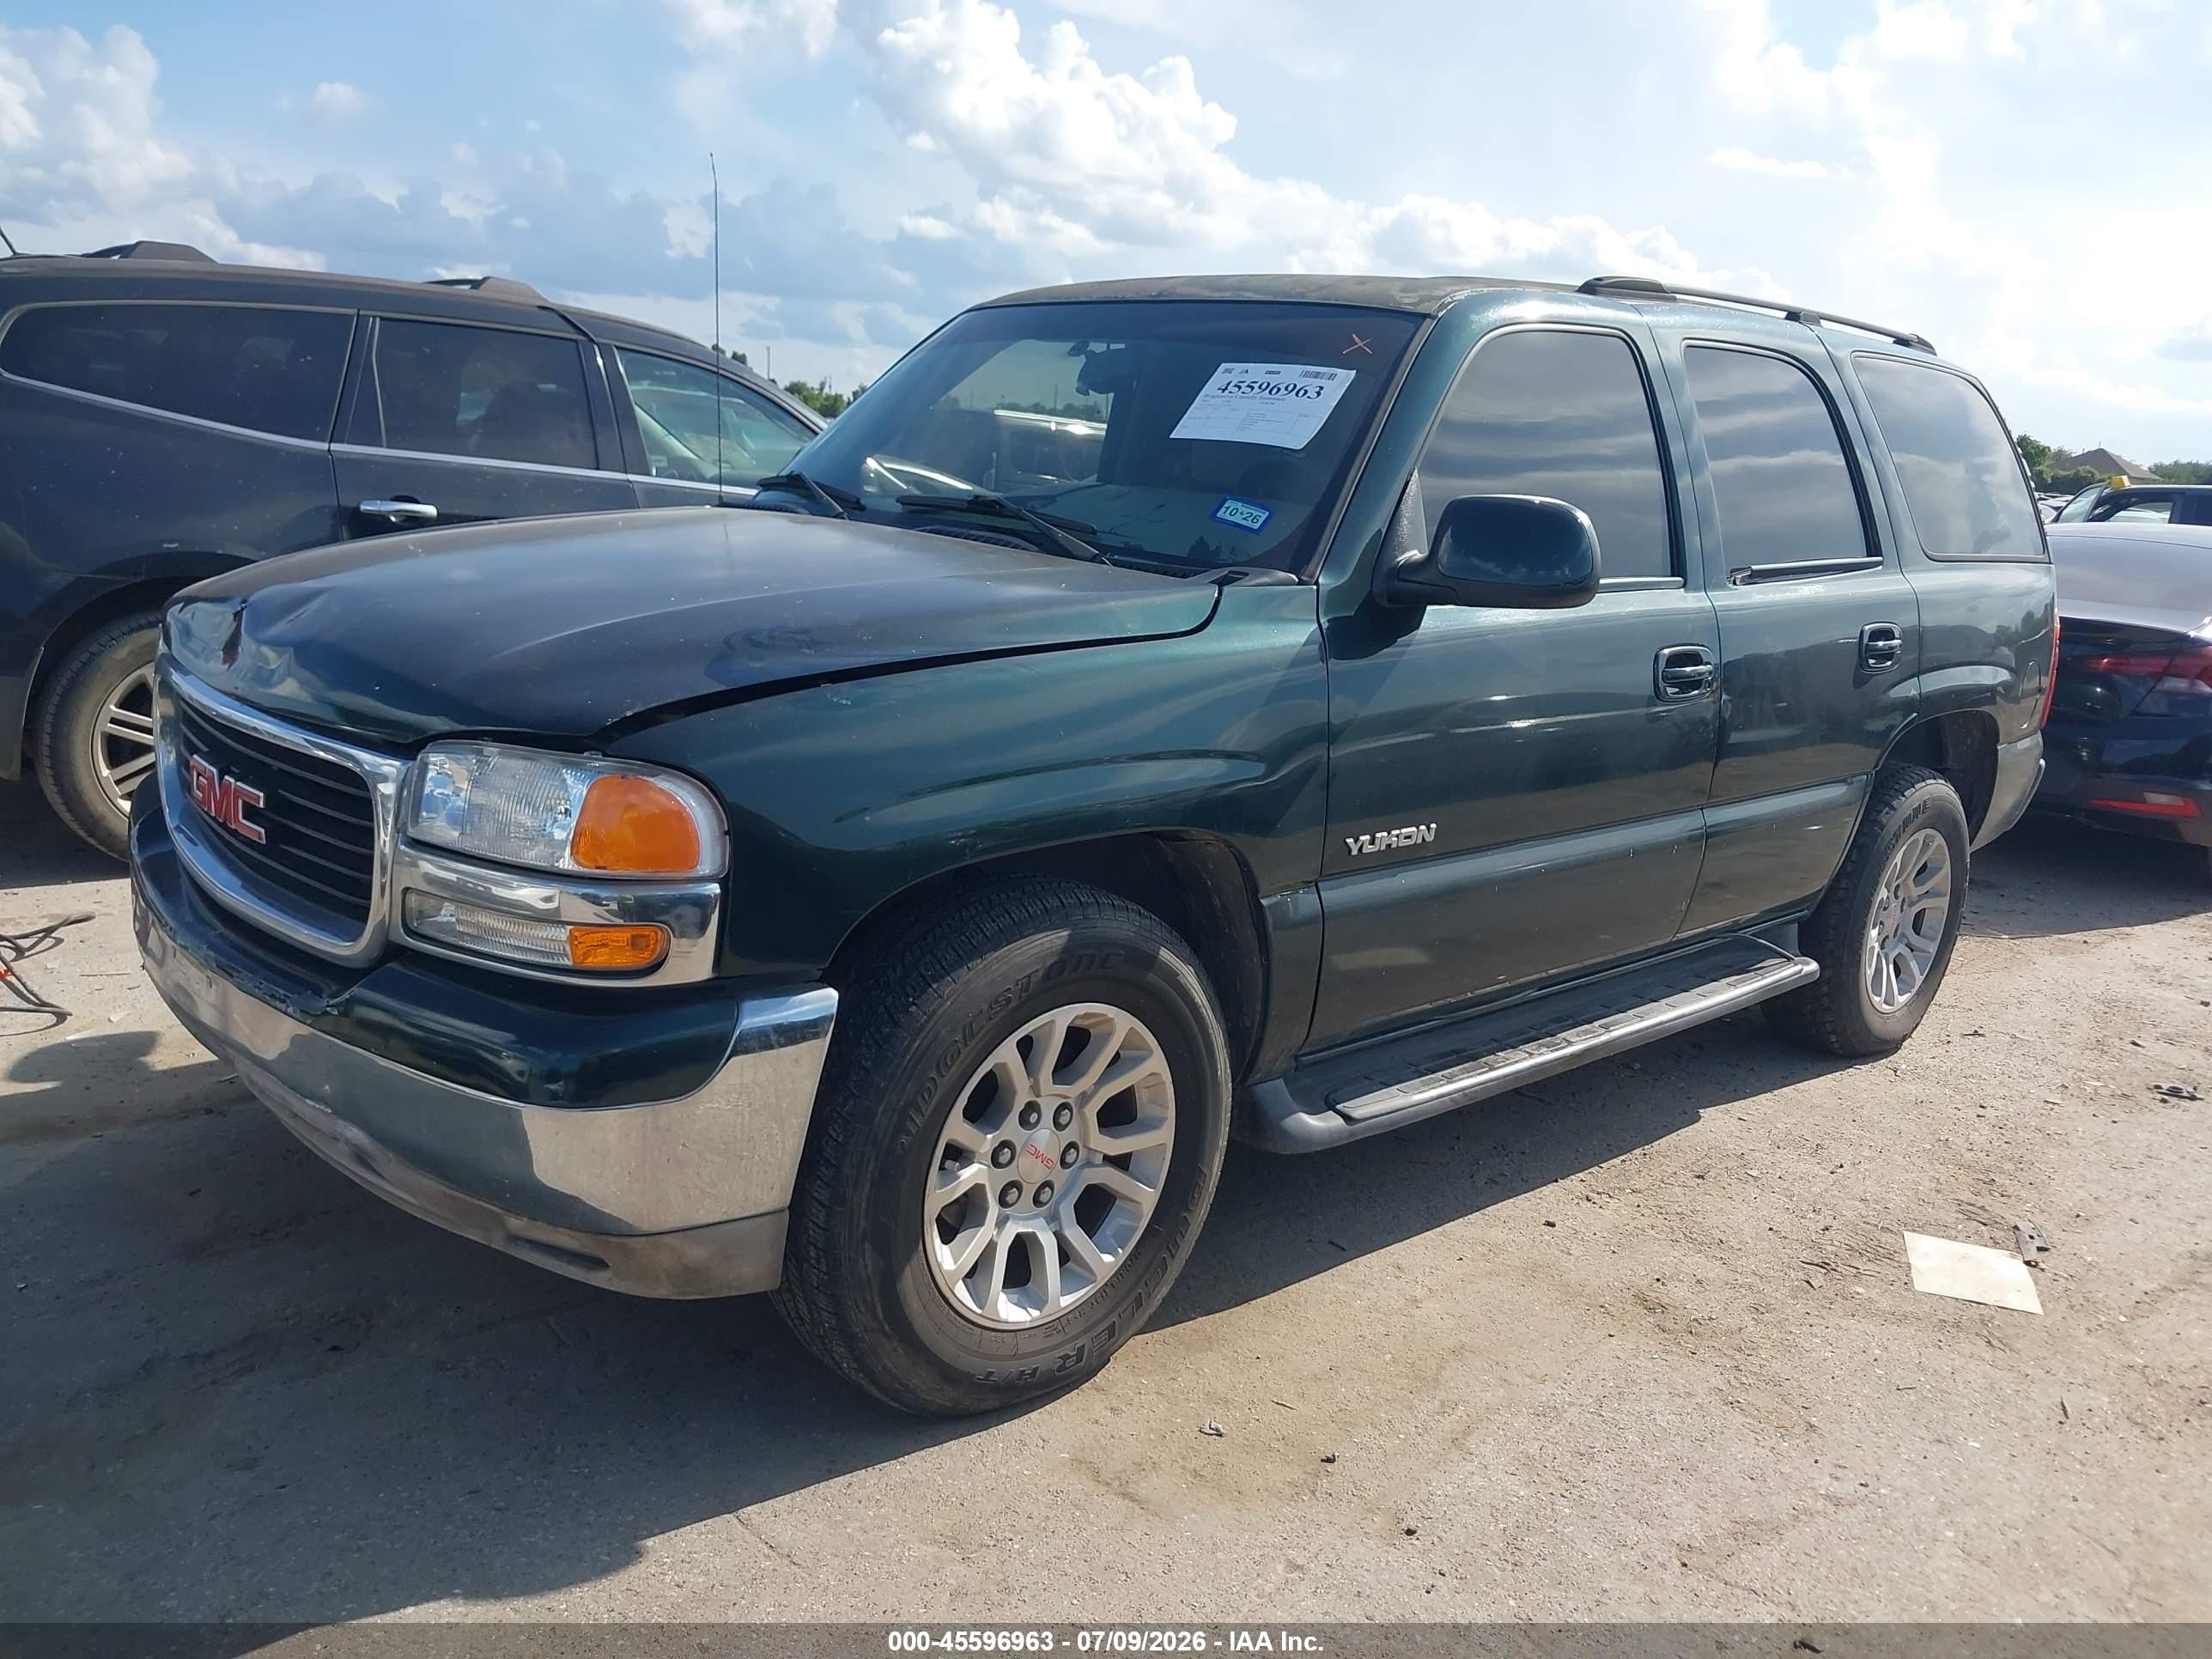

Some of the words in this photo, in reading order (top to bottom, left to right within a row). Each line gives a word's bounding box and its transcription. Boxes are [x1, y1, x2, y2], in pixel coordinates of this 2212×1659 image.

[1217, 380, 1324, 399] 45596963
[189, 753, 266, 845] GMC
[1345, 823, 1437, 856] YUKON
[1024, 1143, 1054, 1170] GMC
[975, 1365, 1040, 1385] H/T
